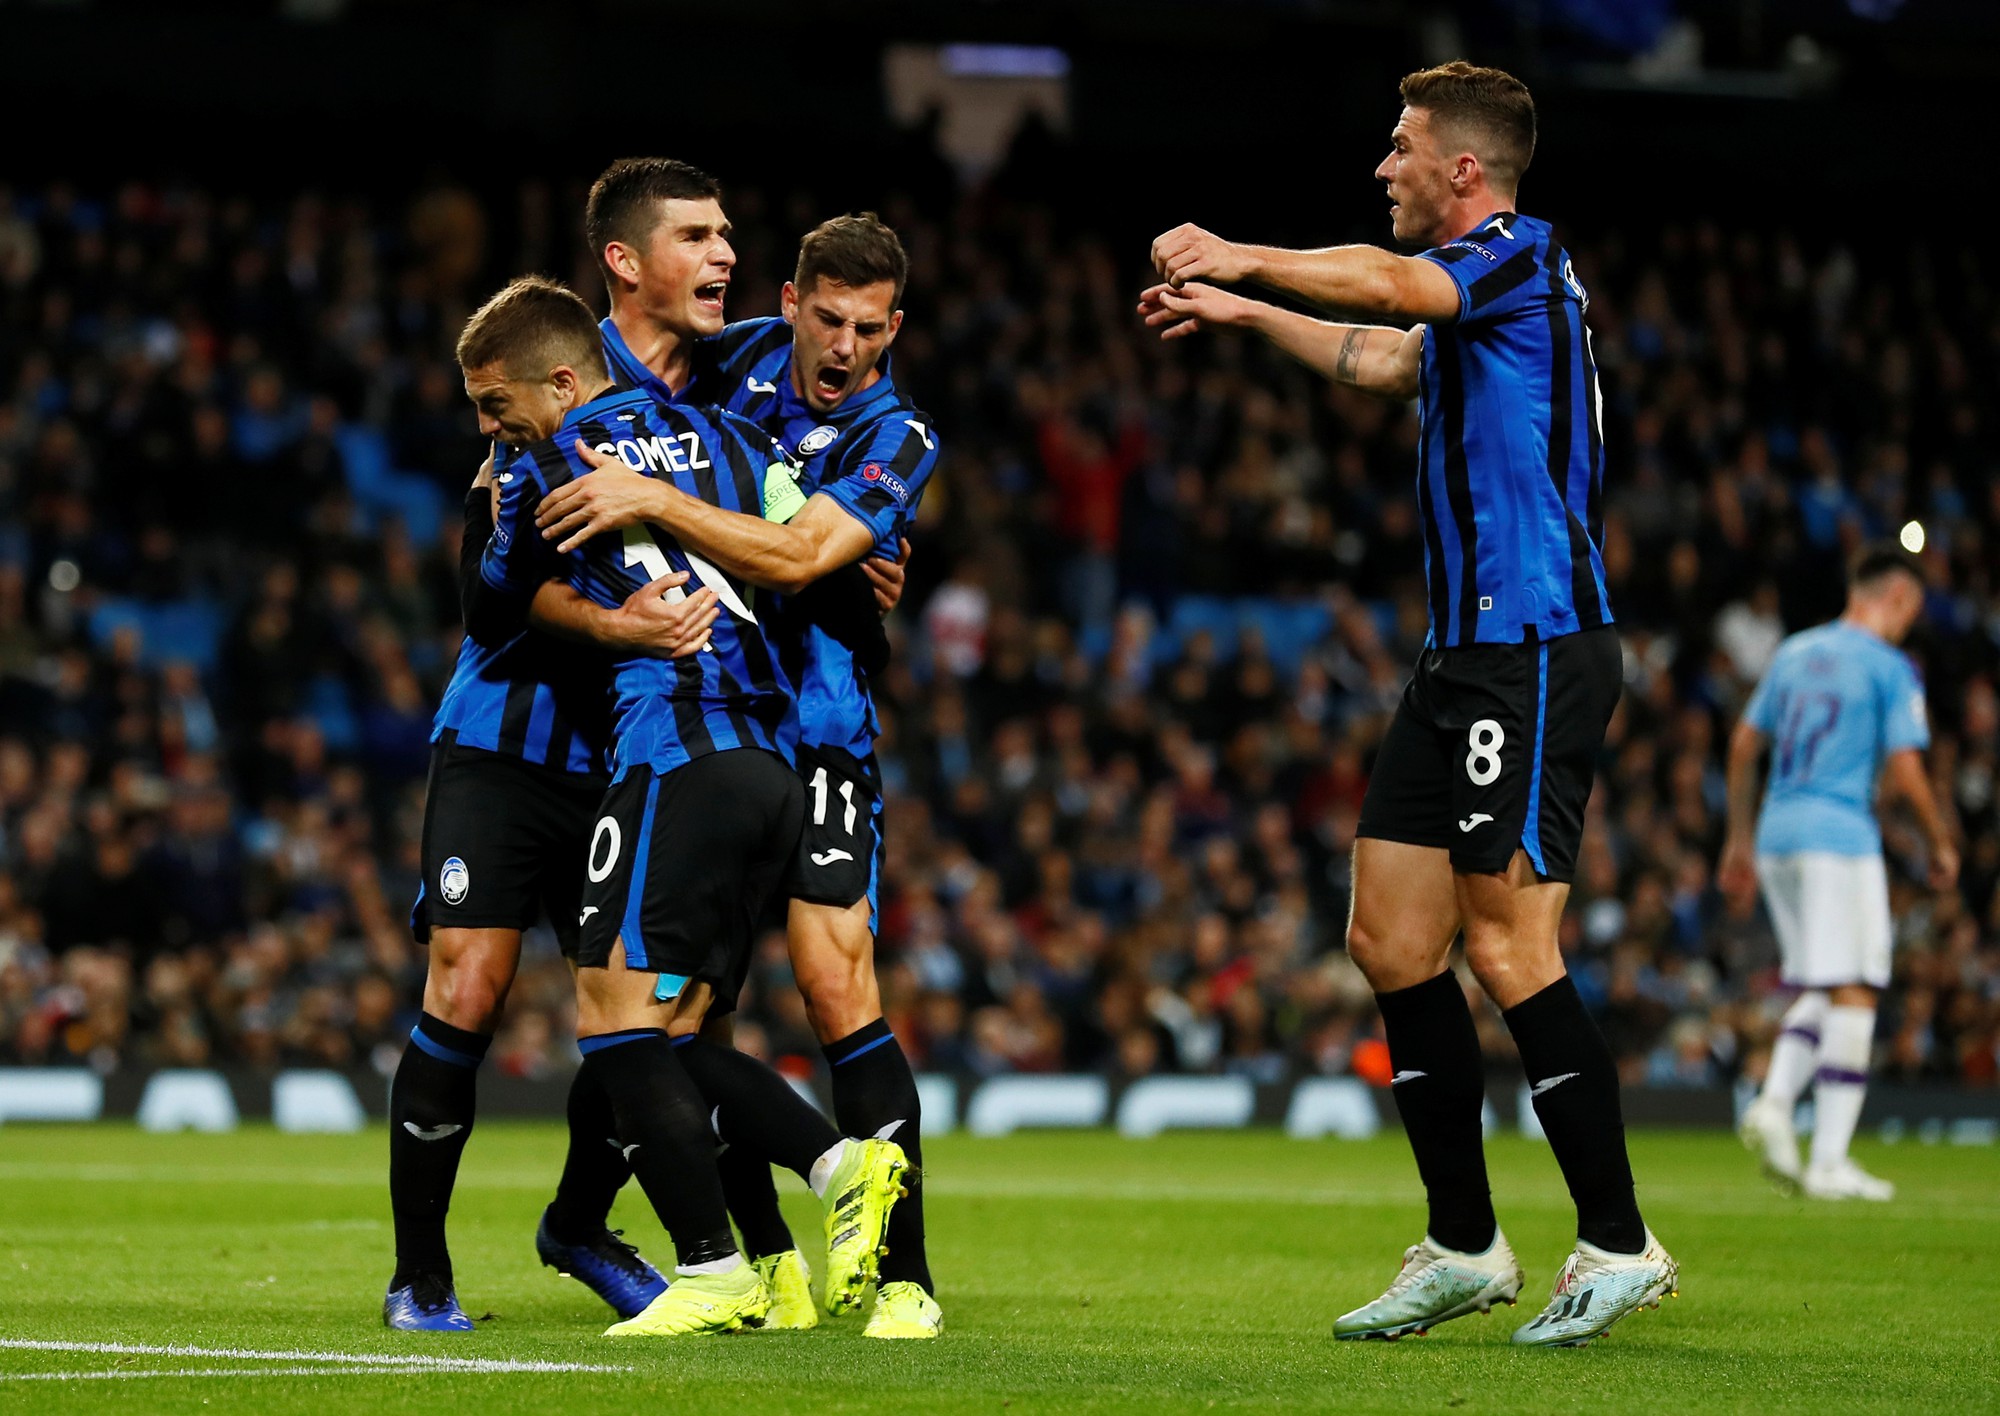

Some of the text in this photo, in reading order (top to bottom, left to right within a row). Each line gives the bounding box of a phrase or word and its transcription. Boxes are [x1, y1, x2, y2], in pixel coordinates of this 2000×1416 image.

[1450, 241, 1497, 261] RESPECT
[764, 481, 796, 507] ESPEC
[879, 473, 909, 504] RESPEC
[1466, 719, 1505, 786] 8
[809, 767, 857, 836] 11
[588, 816, 621, 883] 0
